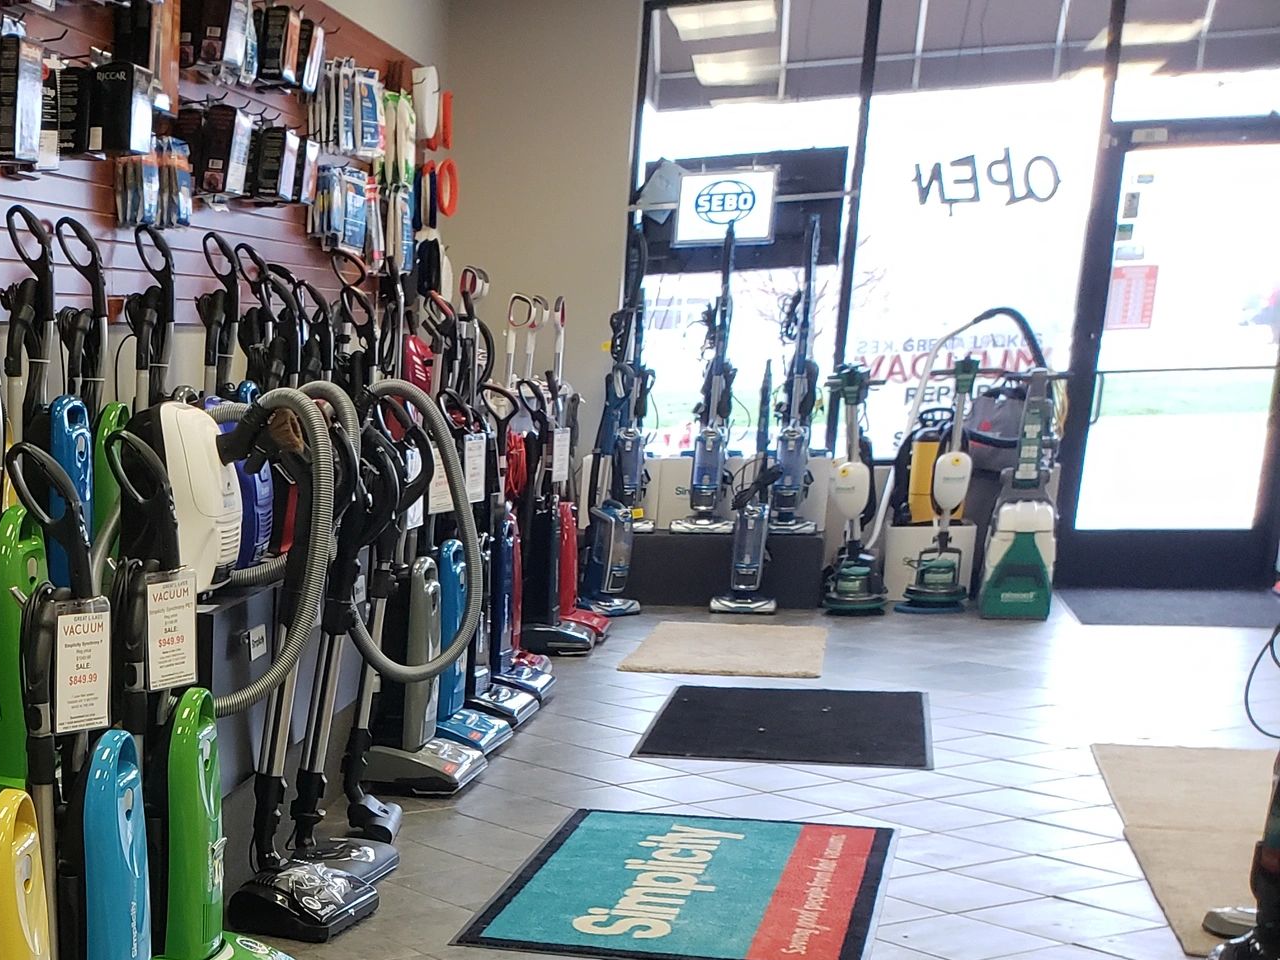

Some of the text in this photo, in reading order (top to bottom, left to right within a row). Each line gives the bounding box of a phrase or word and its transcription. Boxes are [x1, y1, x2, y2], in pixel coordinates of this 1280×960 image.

[96, 71, 127, 81] RICCAR
[696, 191, 754, 213] SEBO
[152, 587, 189, 603] VACUUM
[63, 622, 104, 636] VACUUM
[158, 635, 185, 648] $949.99
[69, 673, 98, 686] $849.99
[571, 824, 746, 939] Simplicity
